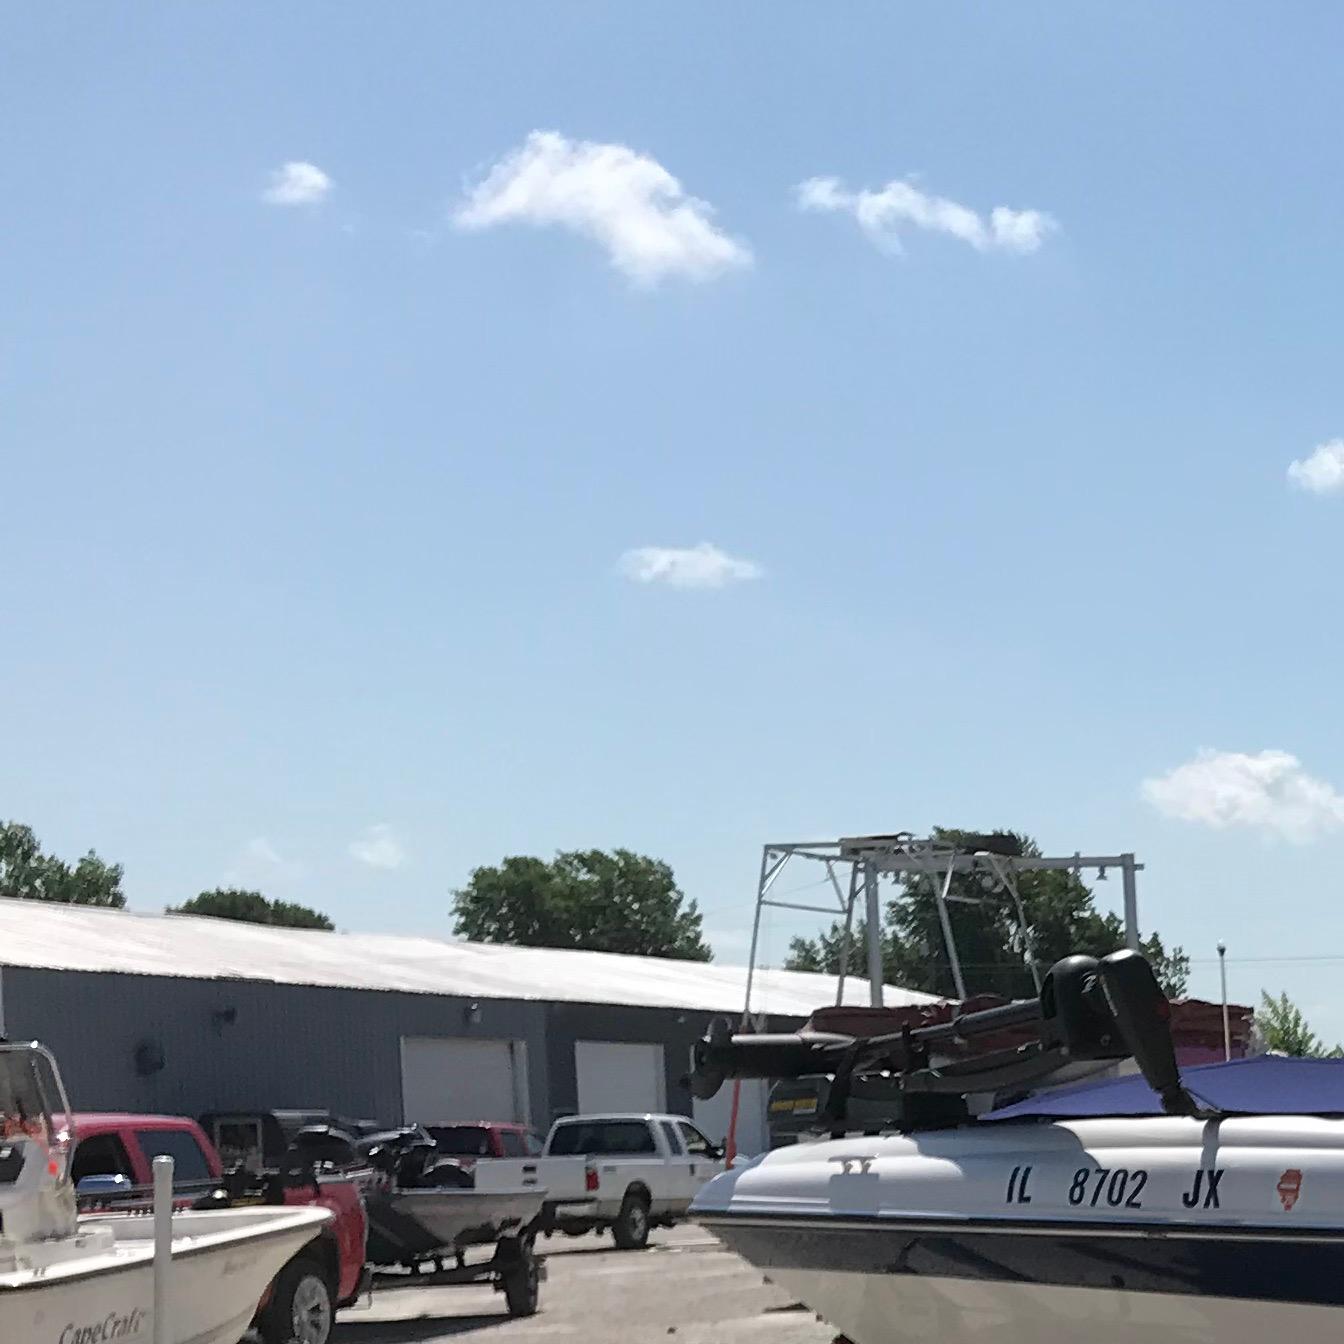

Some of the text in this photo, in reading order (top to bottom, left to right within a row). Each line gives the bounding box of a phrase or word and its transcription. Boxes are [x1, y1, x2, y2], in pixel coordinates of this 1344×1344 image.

[1005, 1166, 1225, 1209] IL 8702 JX
